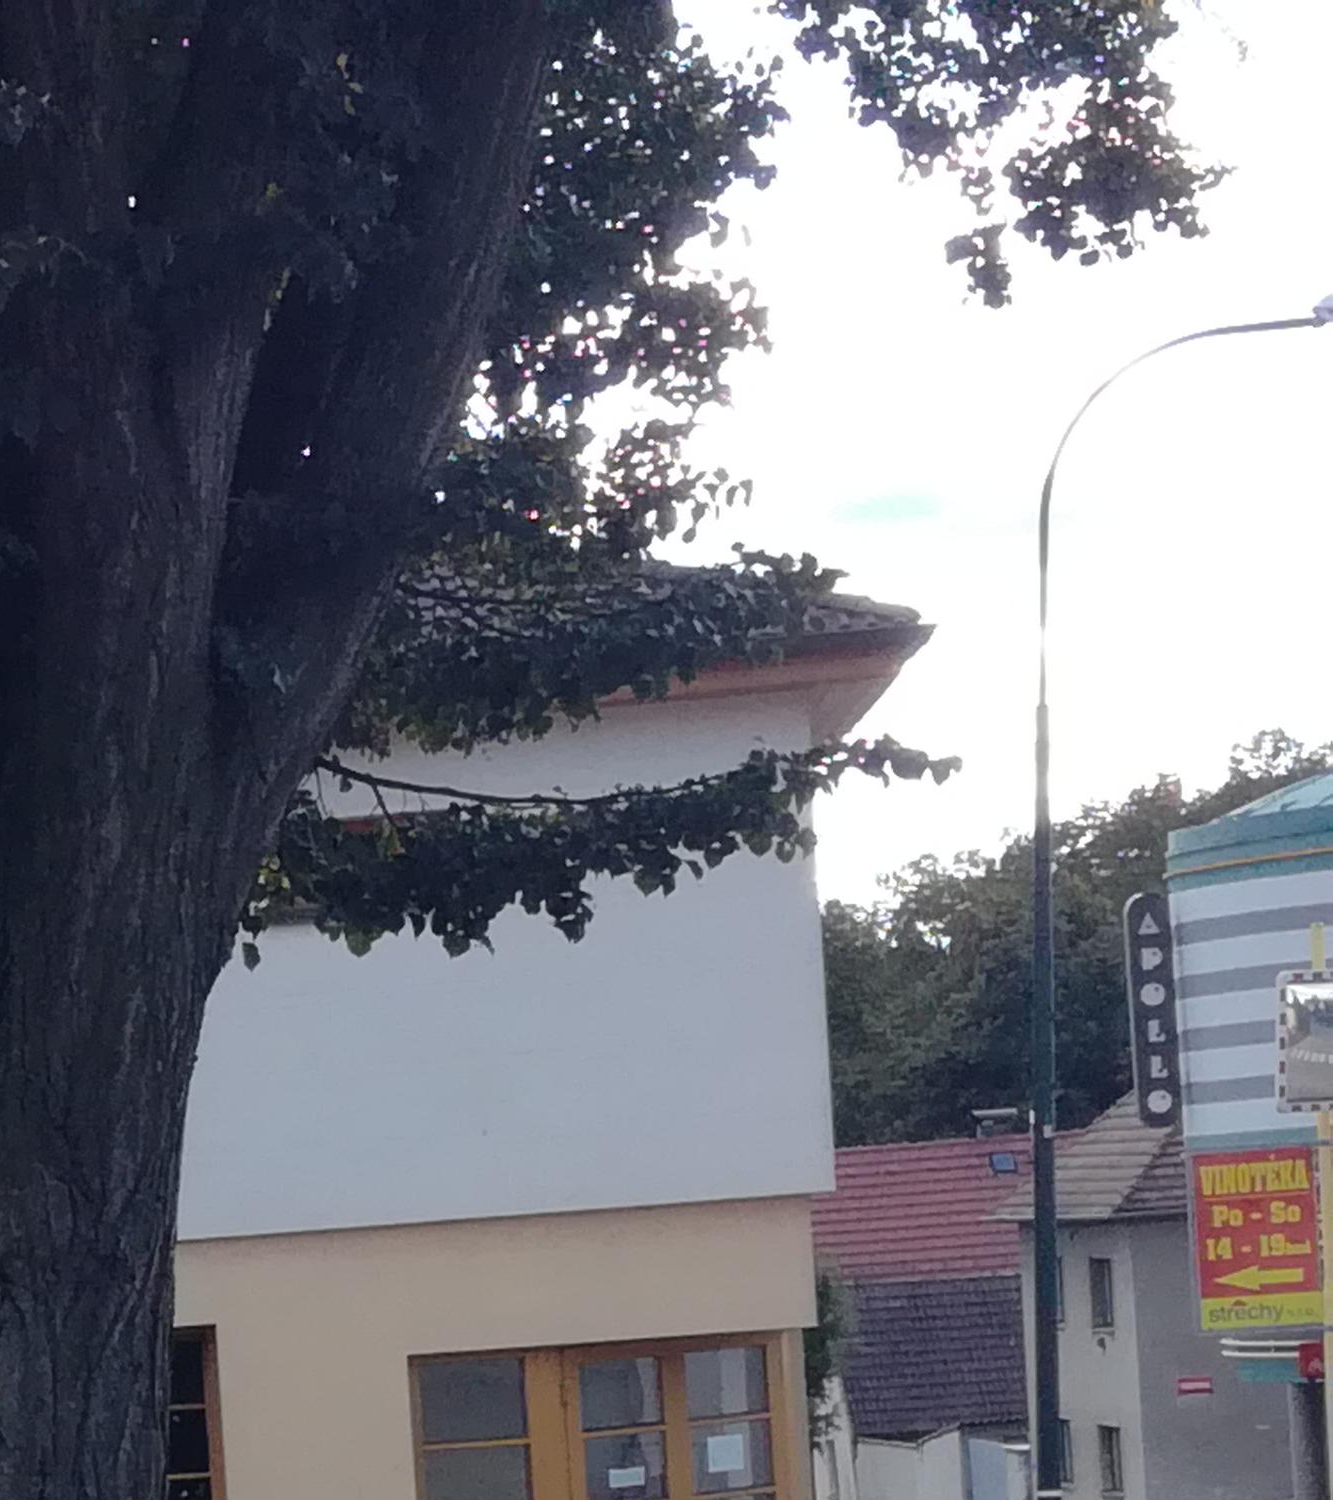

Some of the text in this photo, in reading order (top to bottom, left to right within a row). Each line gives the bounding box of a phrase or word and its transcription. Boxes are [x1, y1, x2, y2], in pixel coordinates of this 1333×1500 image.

[1137, 911, 1173, 1115] APOLLO
[1199, 1153, 1311, 1196] VINOTÉKA
[1211, 1204, 1244, 1228] Po
[1269, 1200, 1302, 1224] So
[1205, 1236, 1233, 1261] 14
